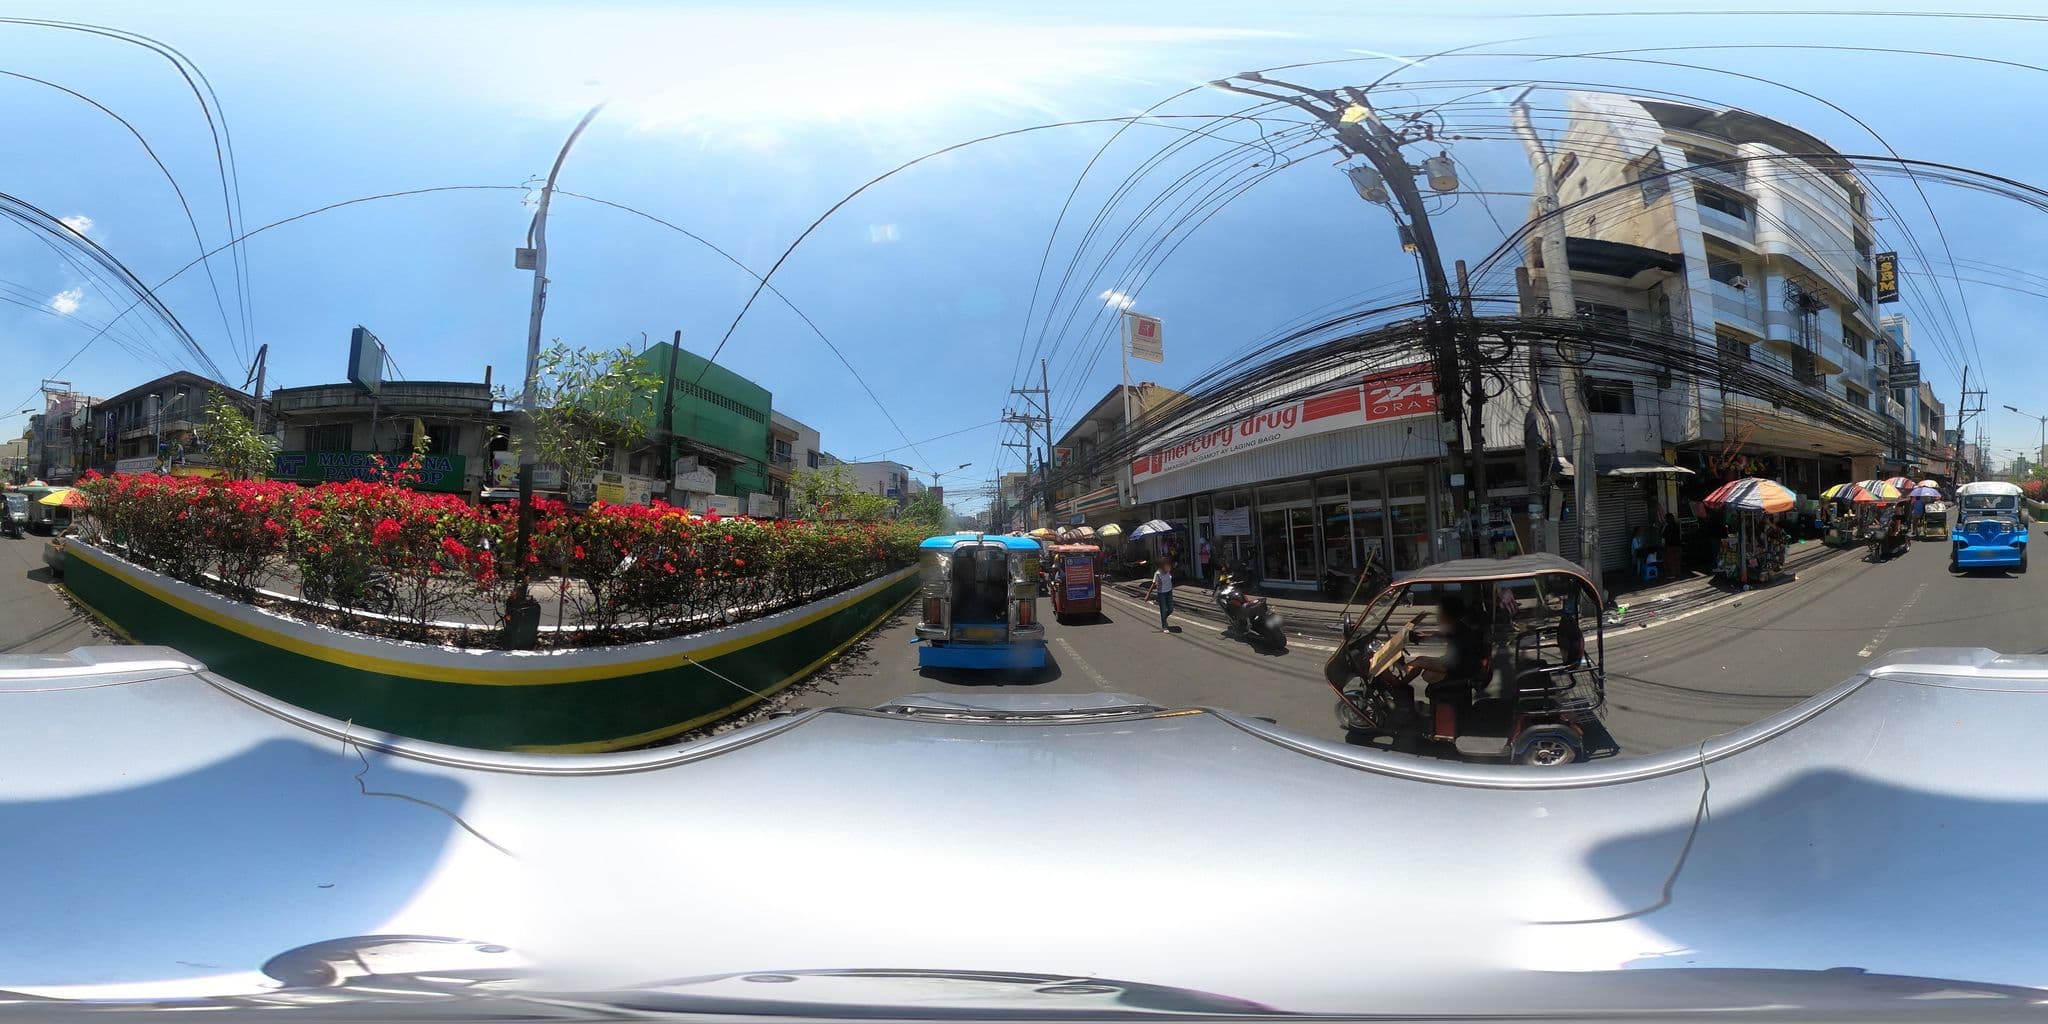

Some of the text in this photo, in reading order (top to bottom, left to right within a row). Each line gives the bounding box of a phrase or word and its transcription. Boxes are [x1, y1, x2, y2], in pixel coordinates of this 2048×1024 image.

[1880, 262, 1895, 291] SBM
[1369, 382, 1434, 404] 24
[1373, 398, 1436, 414] ORAS
[1164, 421, 1233, 463] mercury
[1241, 405, 1298, 436] drug
[1258, 433, 1281, 445] BAGO
[324, 467, 444, 484] PAWNOP
